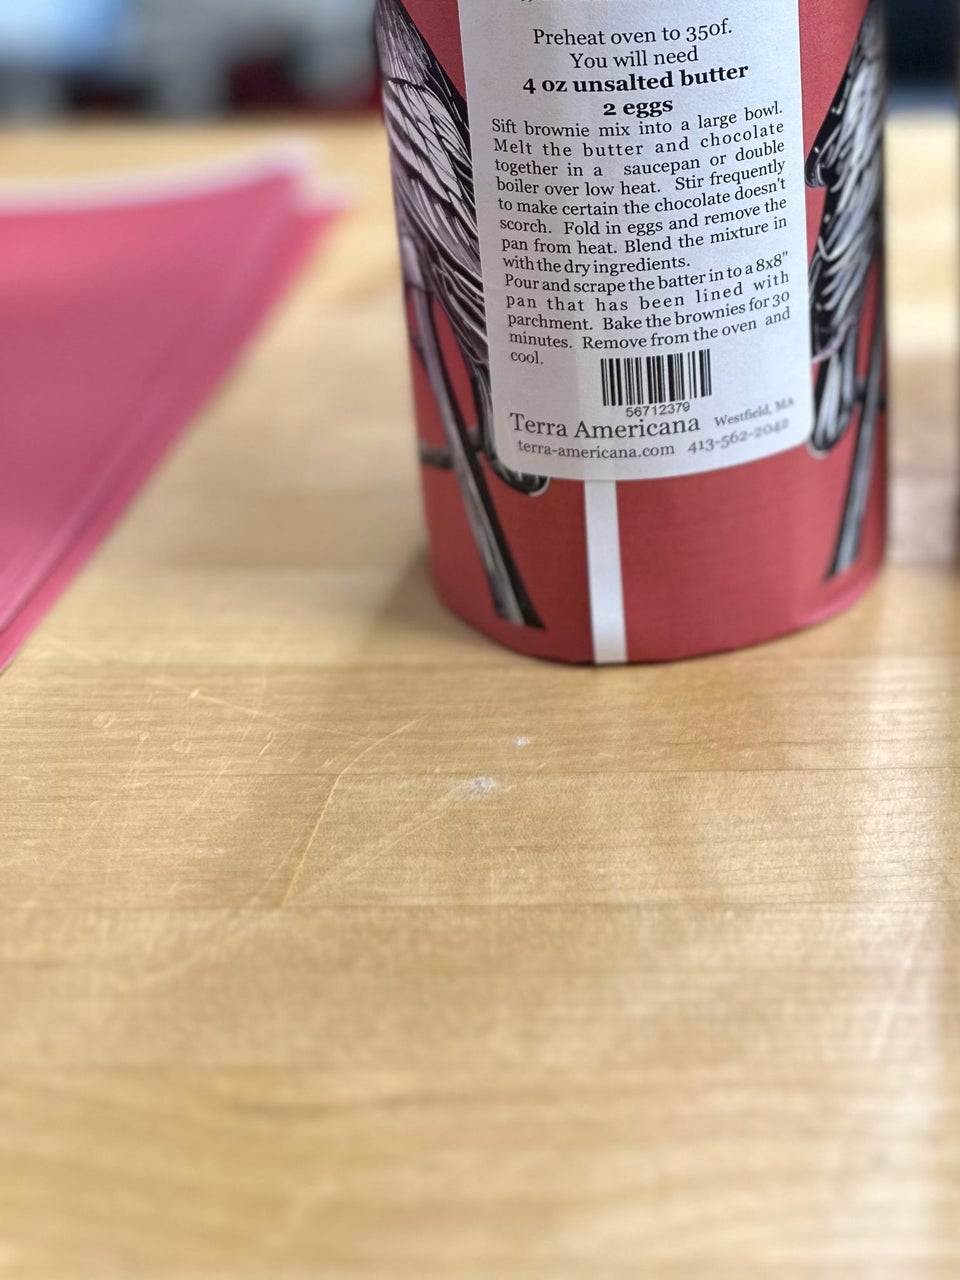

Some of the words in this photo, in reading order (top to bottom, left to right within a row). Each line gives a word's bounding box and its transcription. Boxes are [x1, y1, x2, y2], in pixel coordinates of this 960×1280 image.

[532, 27, 606, 47] Preheat
[611, 28, 657, 45] oven
[662, 27, 681, 42] to
[686, 17, 732, 43] 350f.
[569, 52, 608, 70] You
[613, 49, 648, 68] will
[653, 45, 699, 65] need
[522, 78, 537, 95] 4
[541, 78, 568, 93] oz
[573, 70, 675, 94] unsalted
[680, 64, 749, 87] butter
[492, 118, 518, 135] Sift
[526, 121, 590, 138] brownie
[599, 122, 631, 138] mix
[639, 120, 672, 135] into
[681, 120, 691, 131] a
[698, 113, 738, 131] large
[744, 100, 783, 122] bowl.
[603, 101, 617, 116] 2
[623, 97, 674, 119] eggs
[493, 137, 540, 156] Melt
[542, 141, 573, 158] the
[583, 141, 644, 159] butter
[655, 136, 690, 154] and
[700, 122, 785, 149] chocolate
[494, 157, 559, 179] together
[568, 162, 584, 177] in
[593, 163, 604, 177] a
[625, 157, 701, 178] saucepan
[710, 154, 727, 168] or
[735, 139, 785, 162] double
[496, 174, 539, 195] boiler
[544, 181, 580, 197] over
[585, 179, 615, 197] low
[620, 179, 661, 196] heat.
[675, 174, 703, 192] Stir
[710, 158, 786, 187] frequently
[497, 197, 513, 211] to
[517, 201, 558, 216] make
[562, 197, 619, 216] certain
[622, 197, 652, 215] the
[654, 190, 731, 213] chocolate
[734, 177, 786, 201] doesn't
[499, 218, 552, 234] scorch.
[565, 220, 600, 237] Fold
[605, 220, 622, 235] in
[627, 221, 664, 237] eggs
[668, 213, 699, 231] and
[704, 205, 761, 226] remove
[764, 197, 787, 213] the
[501, 238, 529, 253] pan
[534, 238, 572, 255] from
[578, 238, 618, 256] heat.
[624, 235, 673, 254] Blend
[677, 233, 704, 249] the
[709, 222, 769, 244] mixture
[774, 216, 787, 230] in
[502, 255, 535, 271] with
[536, 257, 562, 273] the
[564, 259, 591, 277] dry
[594, 255, 691, 276] ingredients.
[505, 273, 540, 290] Pour
[542, 277, 571, 294] and
[573, 277, 626, 296] scrape
[628, 276, 656, 291] the
[658, 272, 706, 290] batter
[709, 268, 724, 282] in
[727, 266, 742, 279] to
[745, 264, 753, 275] a
[756, 250, 788, 272] 8x8"
[506, 295, 537, 310] pan
[546, 295, 585, 313] that
[595, 297, 629, 312] has
[640, 295, 685, 310] been
[695, 281, 743, 304] lined
[753, 270, 789, 291] with
[507, 312, 593, 333] parchment.
[603, 316, 643, 332] Bake
[645, 312, 672, 328] the
[675, 303, 746, 326] brownies
[748, 297, 770, 312] for
[772, 291, 790, 308] 30
[509, 331, 573, 349] minutes.
[582, 333, 648, 350] Remove
[650, 332, 690, 347] from
[693, 327, 718, 342] the
[722, 320, 757, 336] oven
[765, 306, 790, 326] and
[510, 350, 544, 365] cool.
[509, 412, 568, 438] Terra
[573, 418, 701, 439] Americana
[626, 401, 690, 418] 56712379
[714, 404, 774, 428] Westfield,
[518, 440, 675, 459] terra-americana.com
